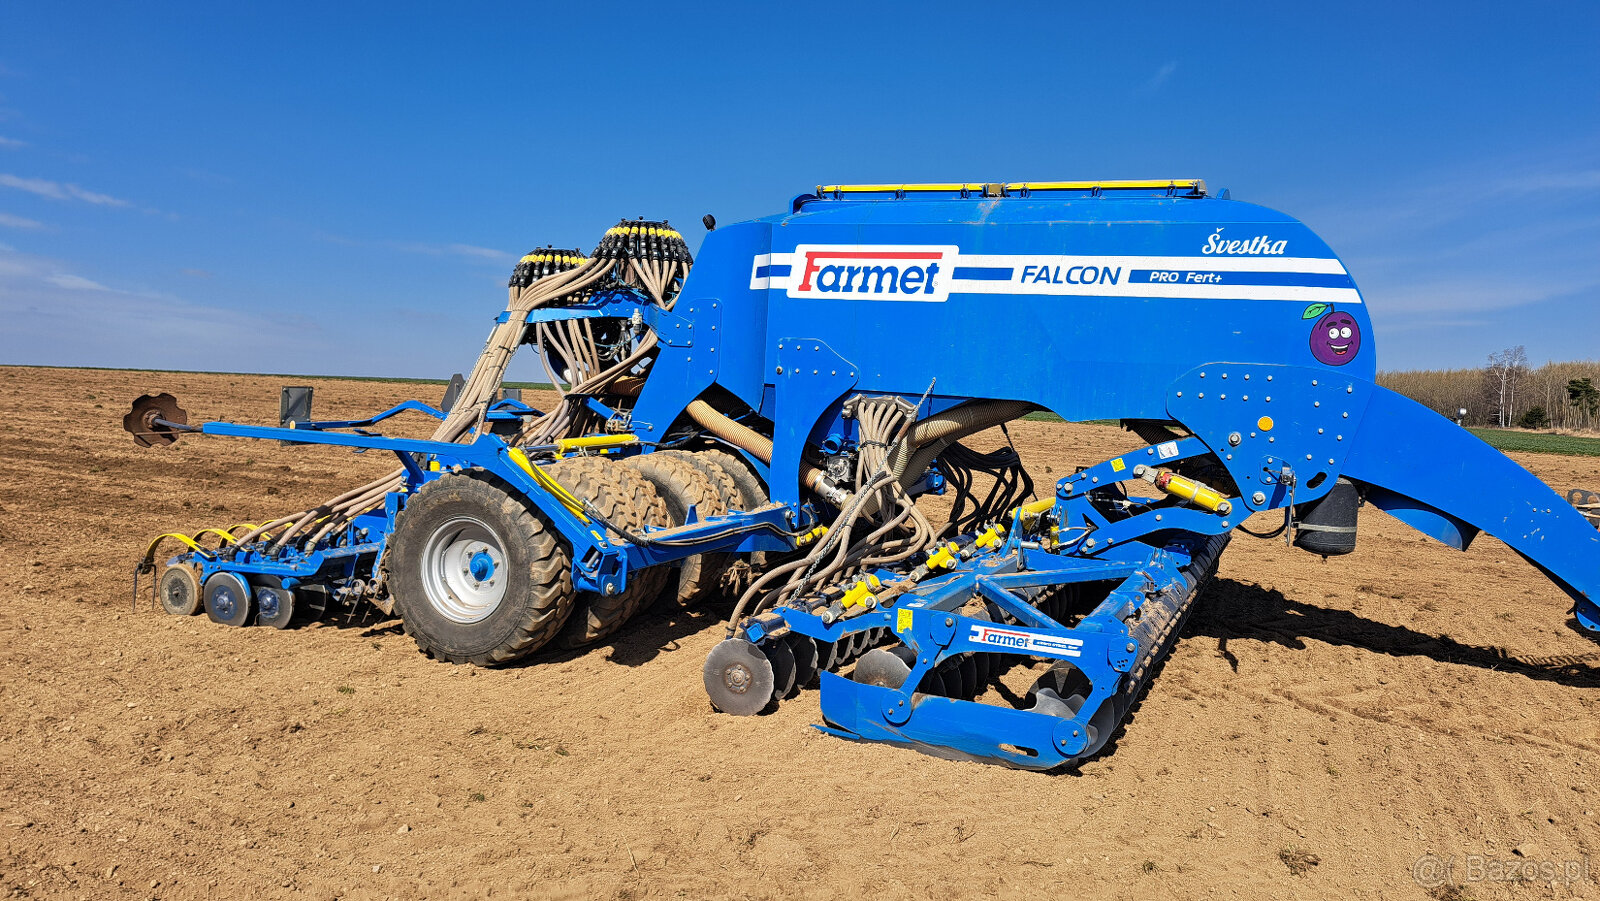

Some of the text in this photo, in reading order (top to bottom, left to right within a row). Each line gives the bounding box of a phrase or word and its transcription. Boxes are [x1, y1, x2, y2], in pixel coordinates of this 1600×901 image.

[1202, 227, 1288, 255] Švestka
[798, 251, 943, 294] Farmet
[1021, 265, 1223, 285] FALCON PRO Fert+
